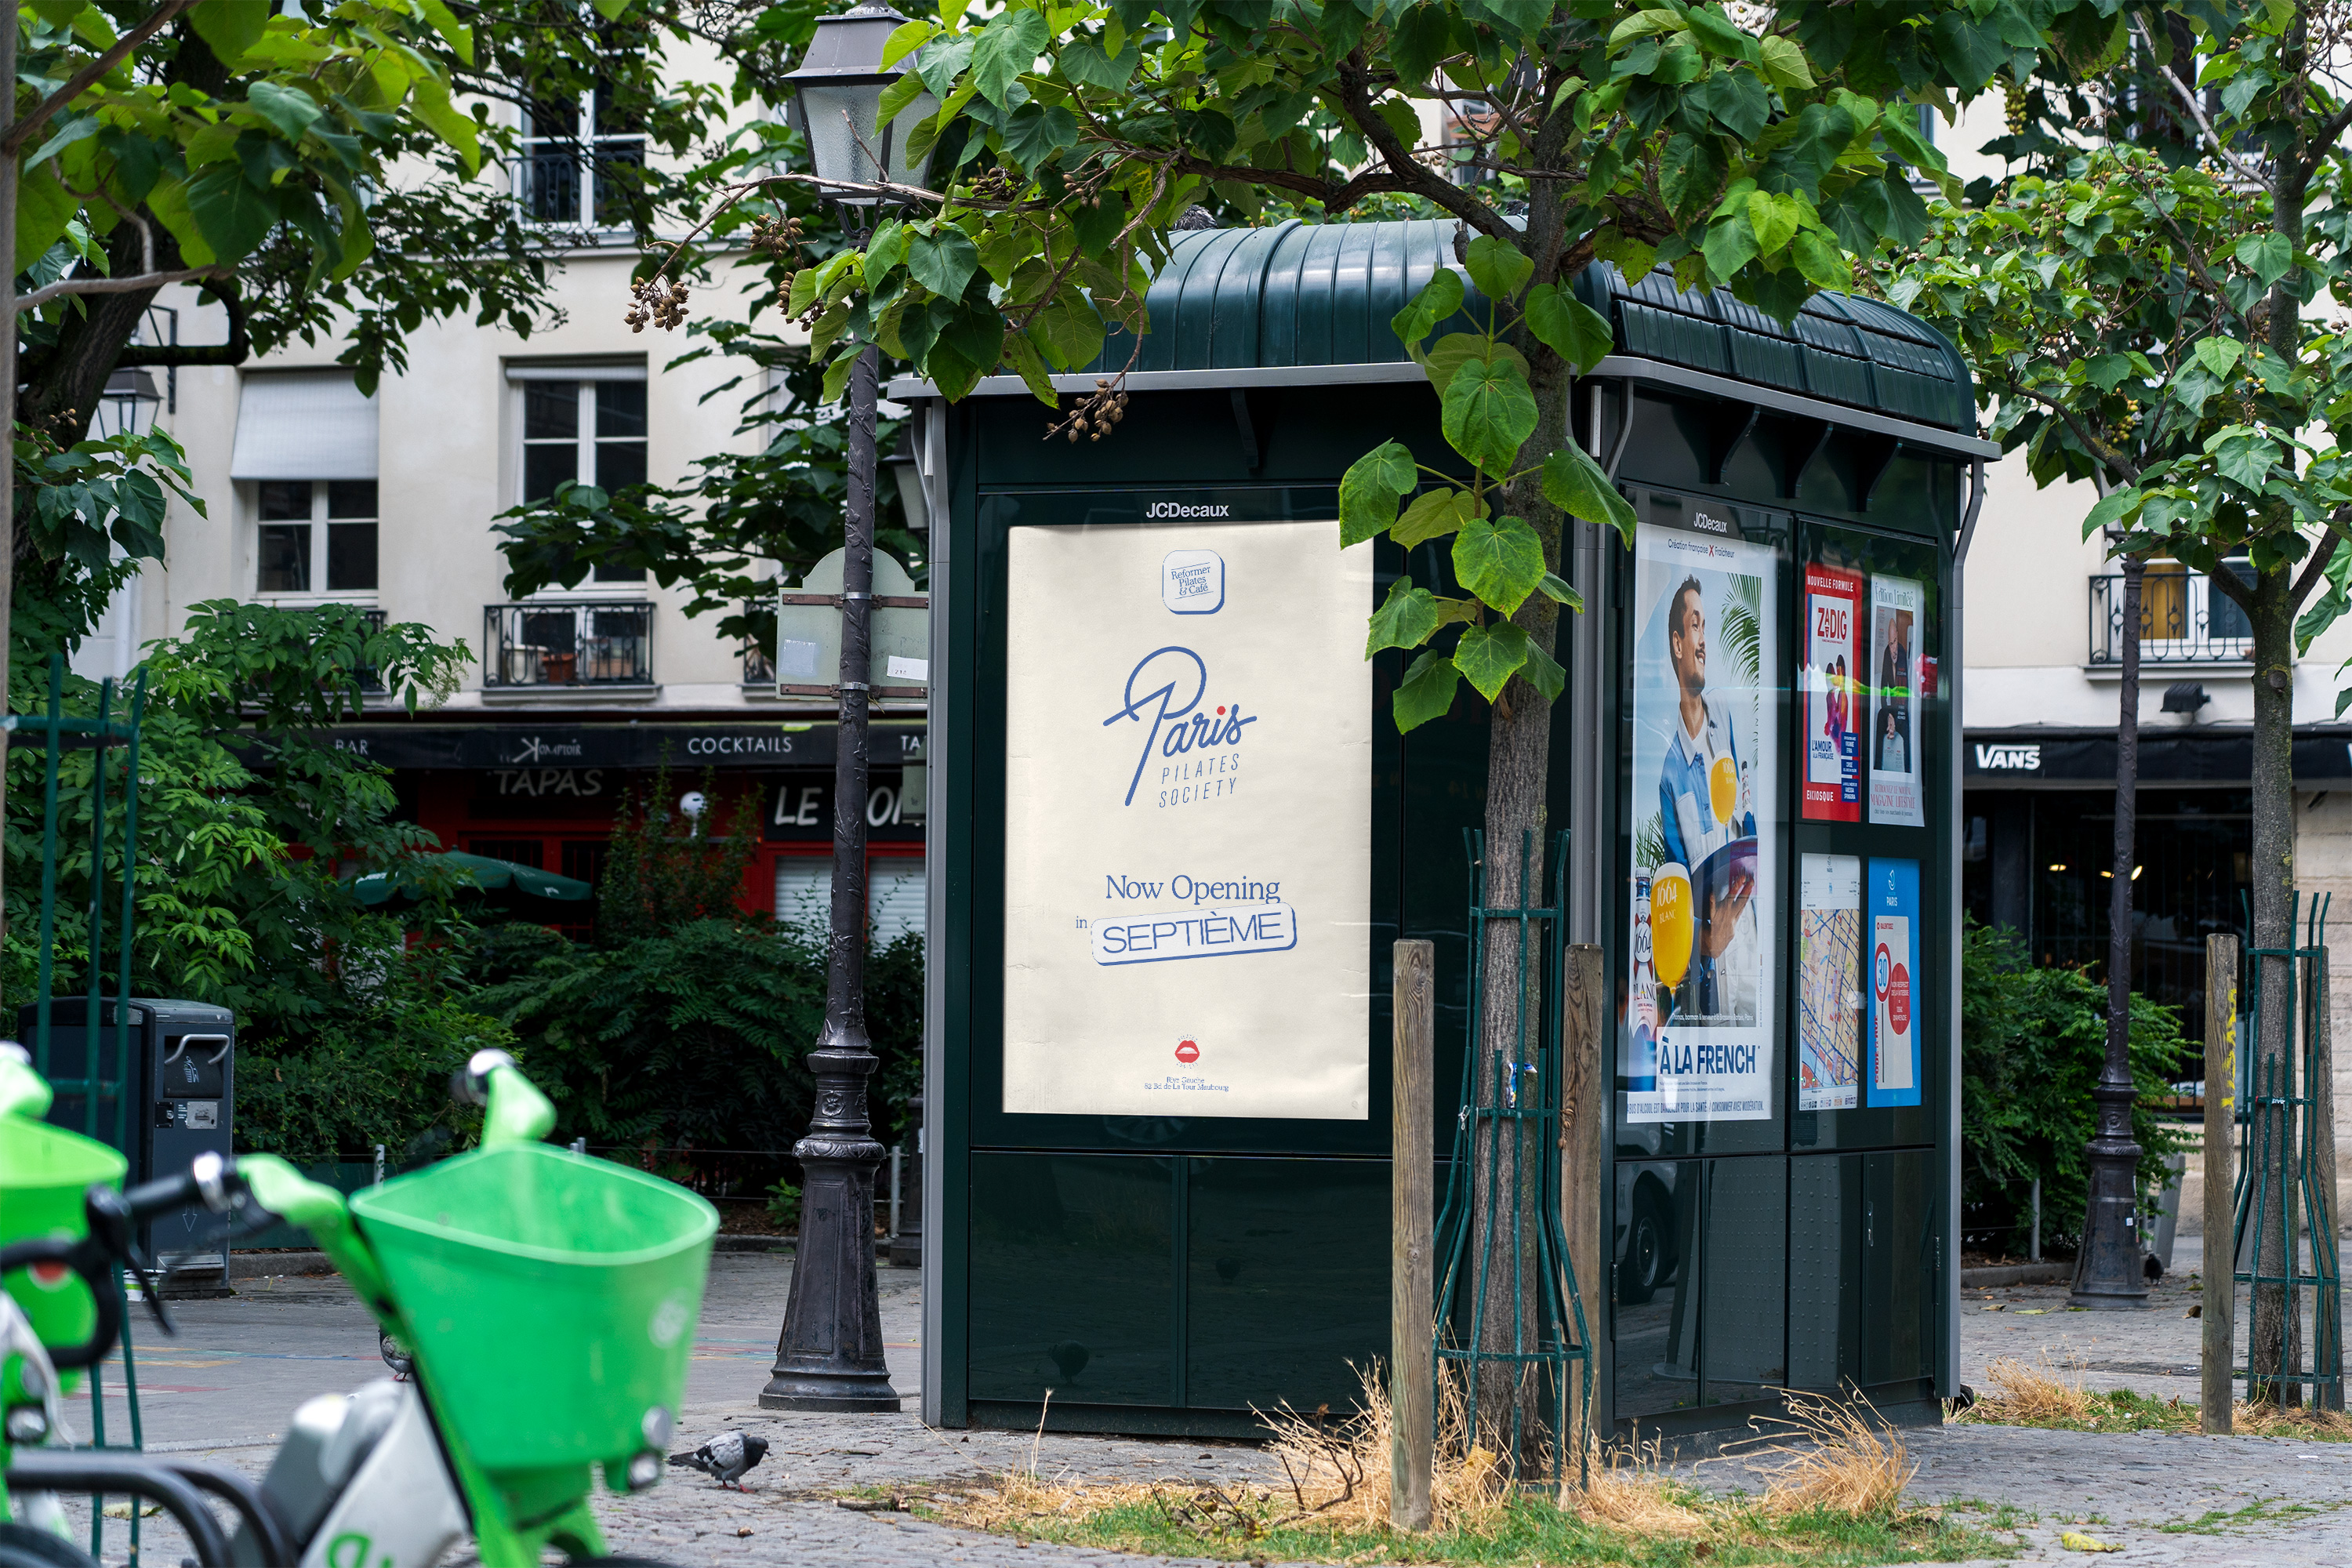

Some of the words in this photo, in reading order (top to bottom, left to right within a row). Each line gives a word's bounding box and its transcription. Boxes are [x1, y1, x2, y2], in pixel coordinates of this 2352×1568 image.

[1146, 502, 1229, 518] JCDecaux
[1693, 512, 1728, 533] JCDecaux
[1171, 566, 1210, 579] Reformer
[1178, 576, 1207, 587] Pilates
[1179, 587, 1187, 596] &
[1189, 583, 1209, 593] Café
[1807, 575, 1831, 589] NOUVELLE
[1832, 579, 1853, 592] FORMULE
[1817, 607, 1847, 641] ZADIG
[1103, 646, 1258, 806] Paris
[336, 739, 368, 755] BAR
[688, 736, 793, 754] COCKTAILS
[1811, 739, 1832, 753] L'AMOUR
[1975, 744, 2041, 771] VANS
[1162, 753, 1240, 785] PILATES
[493, 768, 604, 797] TAPAS
[1159, 777, 1238, 809] SOCIETY
[775, 786, 822, 826] LE
[1812, 790, 1834, 802] KIOSQUE
[1105, 875, 1164, 900] Now
[1171, 874, 1281, 905] Opening
[1656, 879, 1678, 908] 1664
[1886, 896, 1897, 906] PARIS
[1659, 909, 1676, 924] BLANC
[1076, 916, 1088, 929] in
[1102, 911, 1284, 953] SEPTIÈME
[1635, 927, 1652, 954] 1664
[1878, 958, 1887, 987] 30
[1633, 984, 1656, 1002] BLANC
[1660, 1035, 1671, 1074] À
[1674, 1045, 1693, 1074] LA
[1697, 1045, 1756, 1074] FRENCH
[1197, 1083, 1229, 1093] Maubourg
